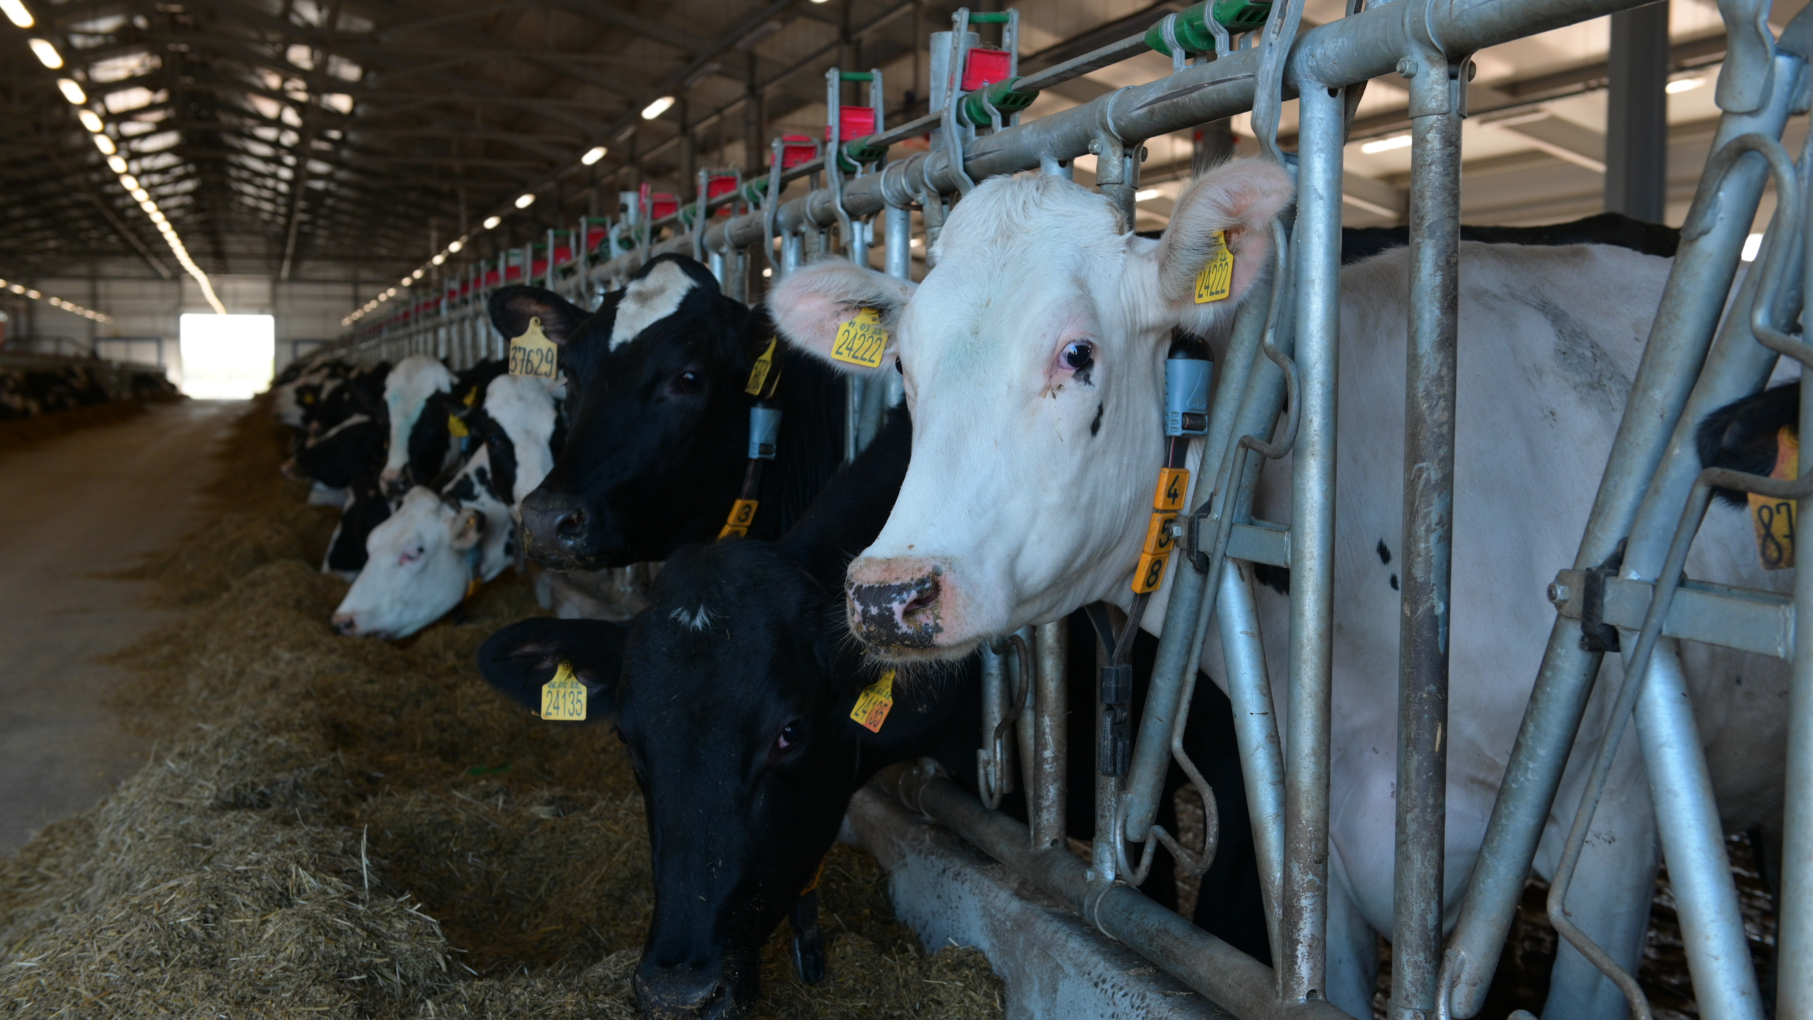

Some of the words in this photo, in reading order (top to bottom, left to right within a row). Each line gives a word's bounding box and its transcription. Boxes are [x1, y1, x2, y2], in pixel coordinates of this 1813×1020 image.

[1198, 262, 1228, 298] 24222
[509, 345, 554, 378] 37629
[835, 329, 883, 364] 24222
[1166, 474, 1180, 506] 4
[738, 504, 752, 523] 3
[1145, 559, 1163, 588] 8
[546, 690, 584, 717] 24135
[854, 692, 889, 728] 24135
